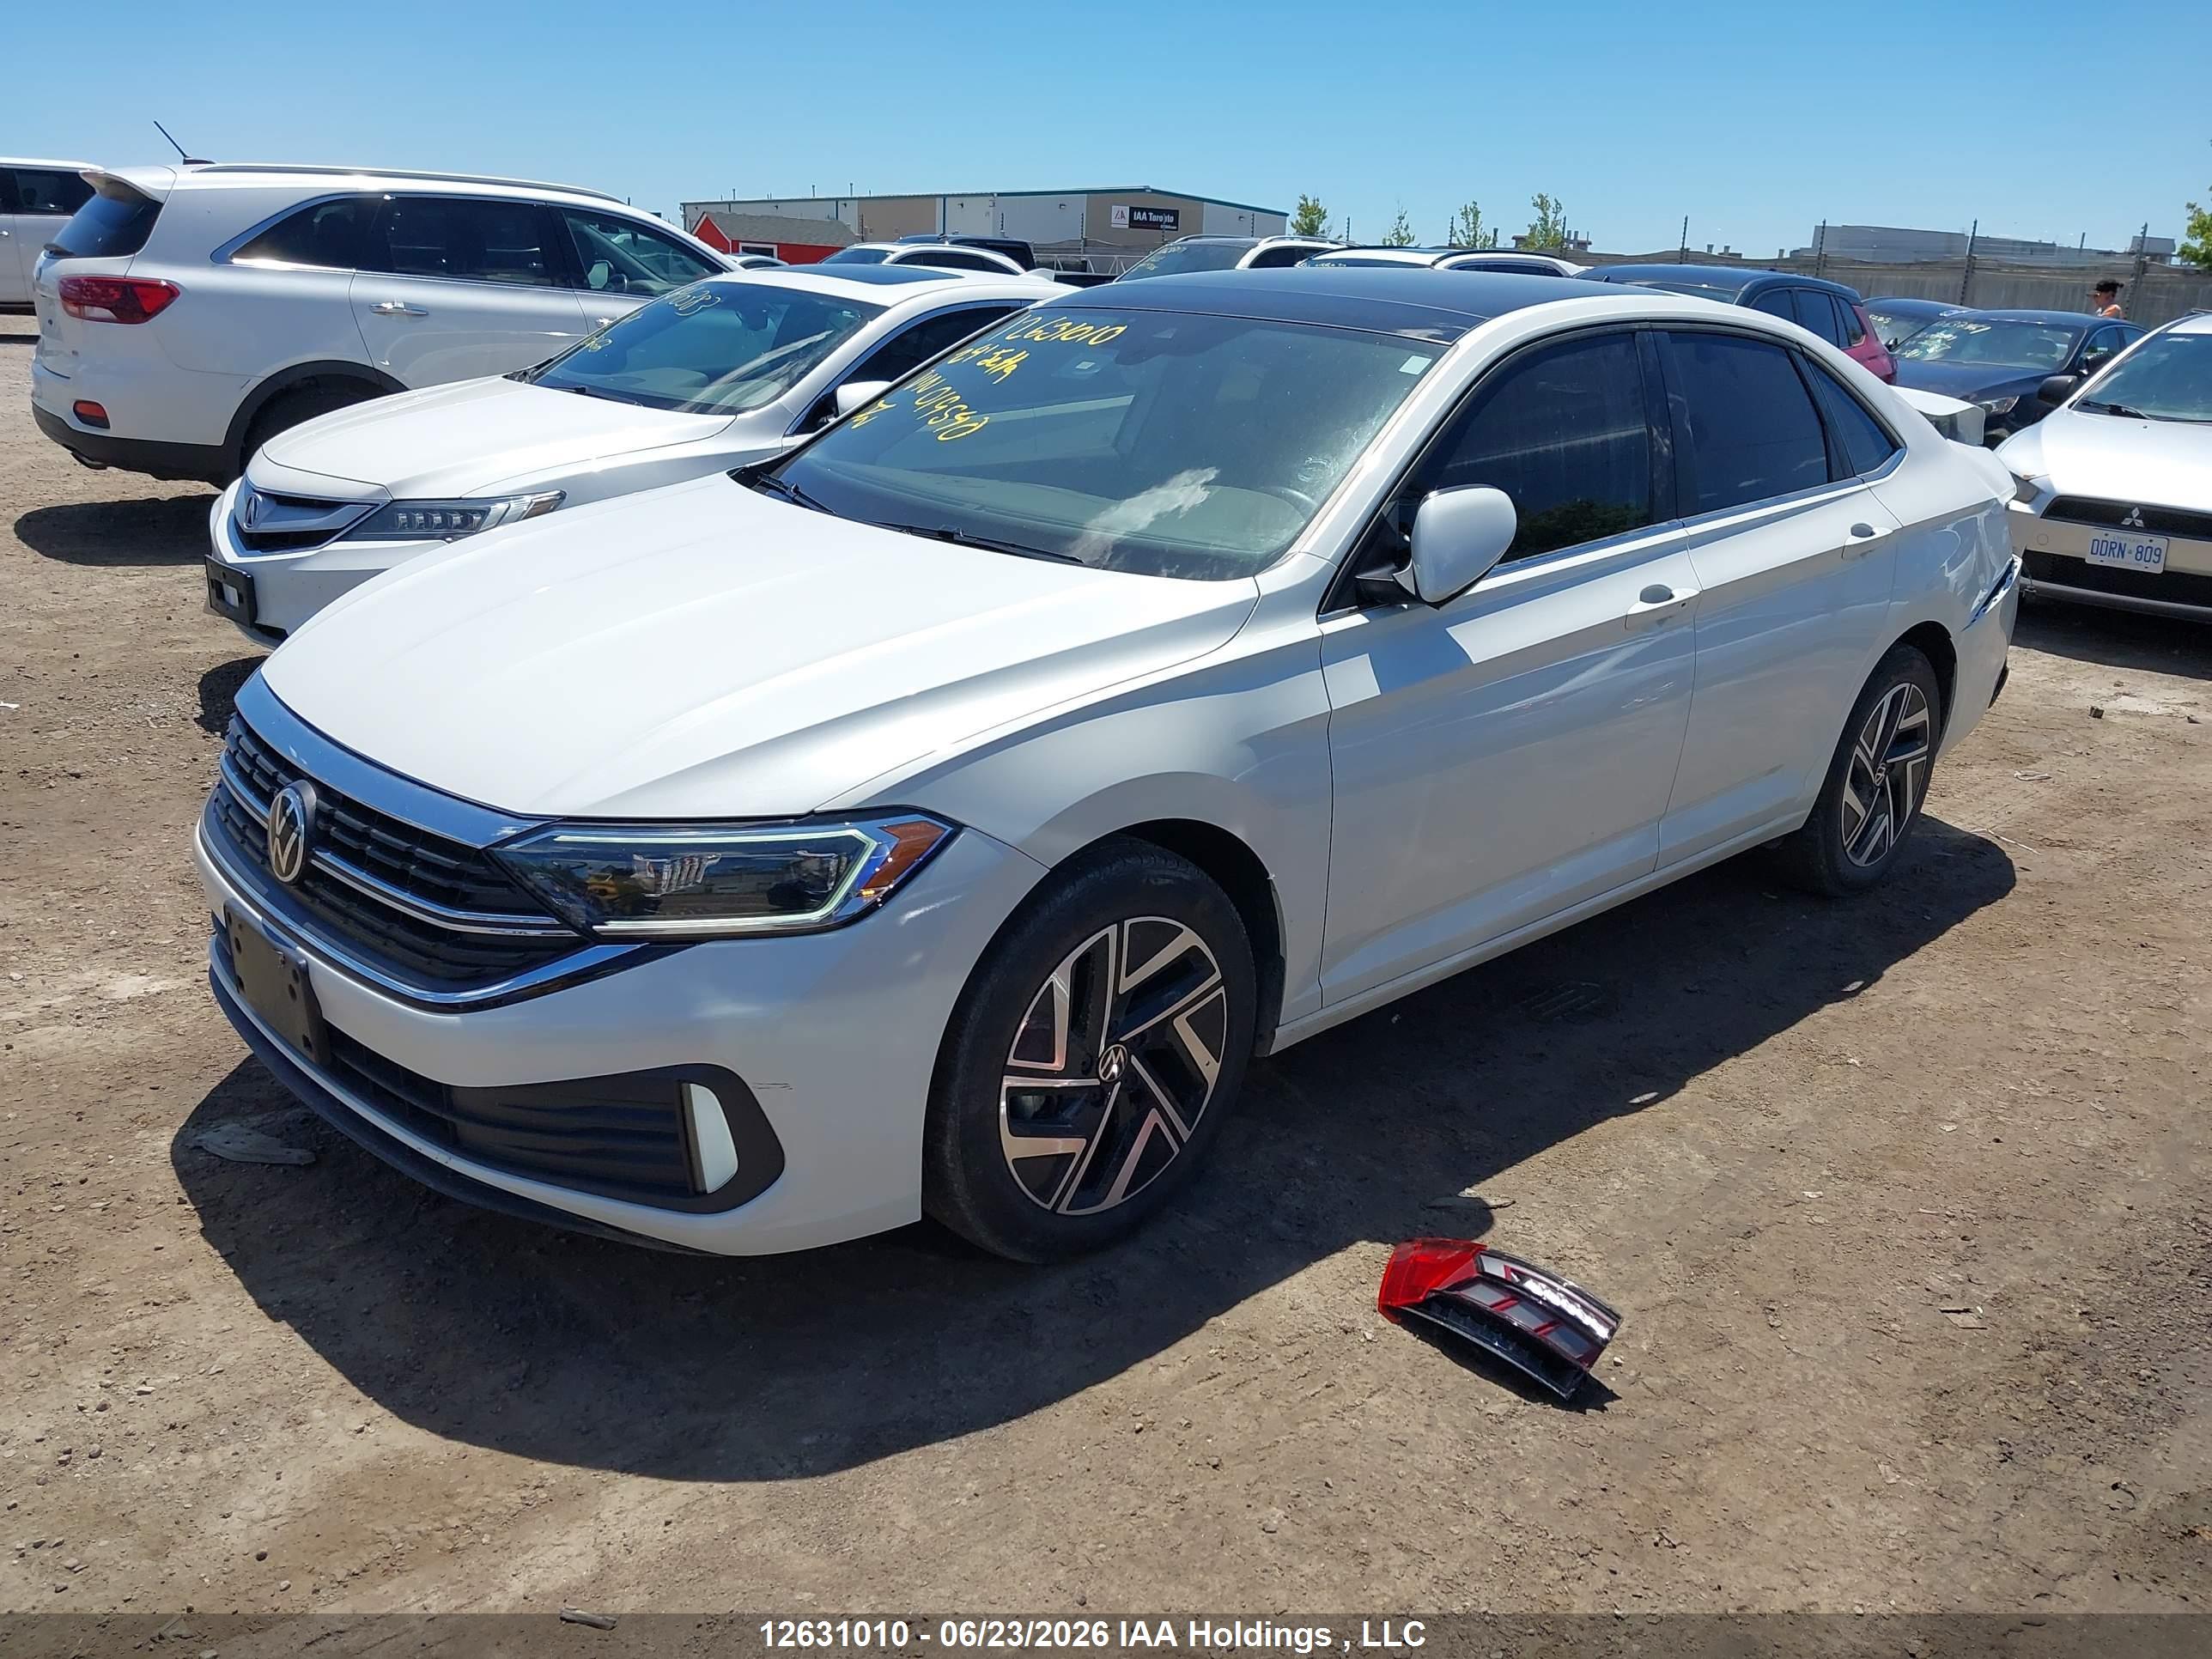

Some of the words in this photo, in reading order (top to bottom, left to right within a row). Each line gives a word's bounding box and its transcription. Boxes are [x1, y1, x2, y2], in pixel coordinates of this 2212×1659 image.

[1133, 211, 1147, 221] IAA
[987, 313, 1128, 346] 12631010
[2135, 544, 2163, 564] 809
